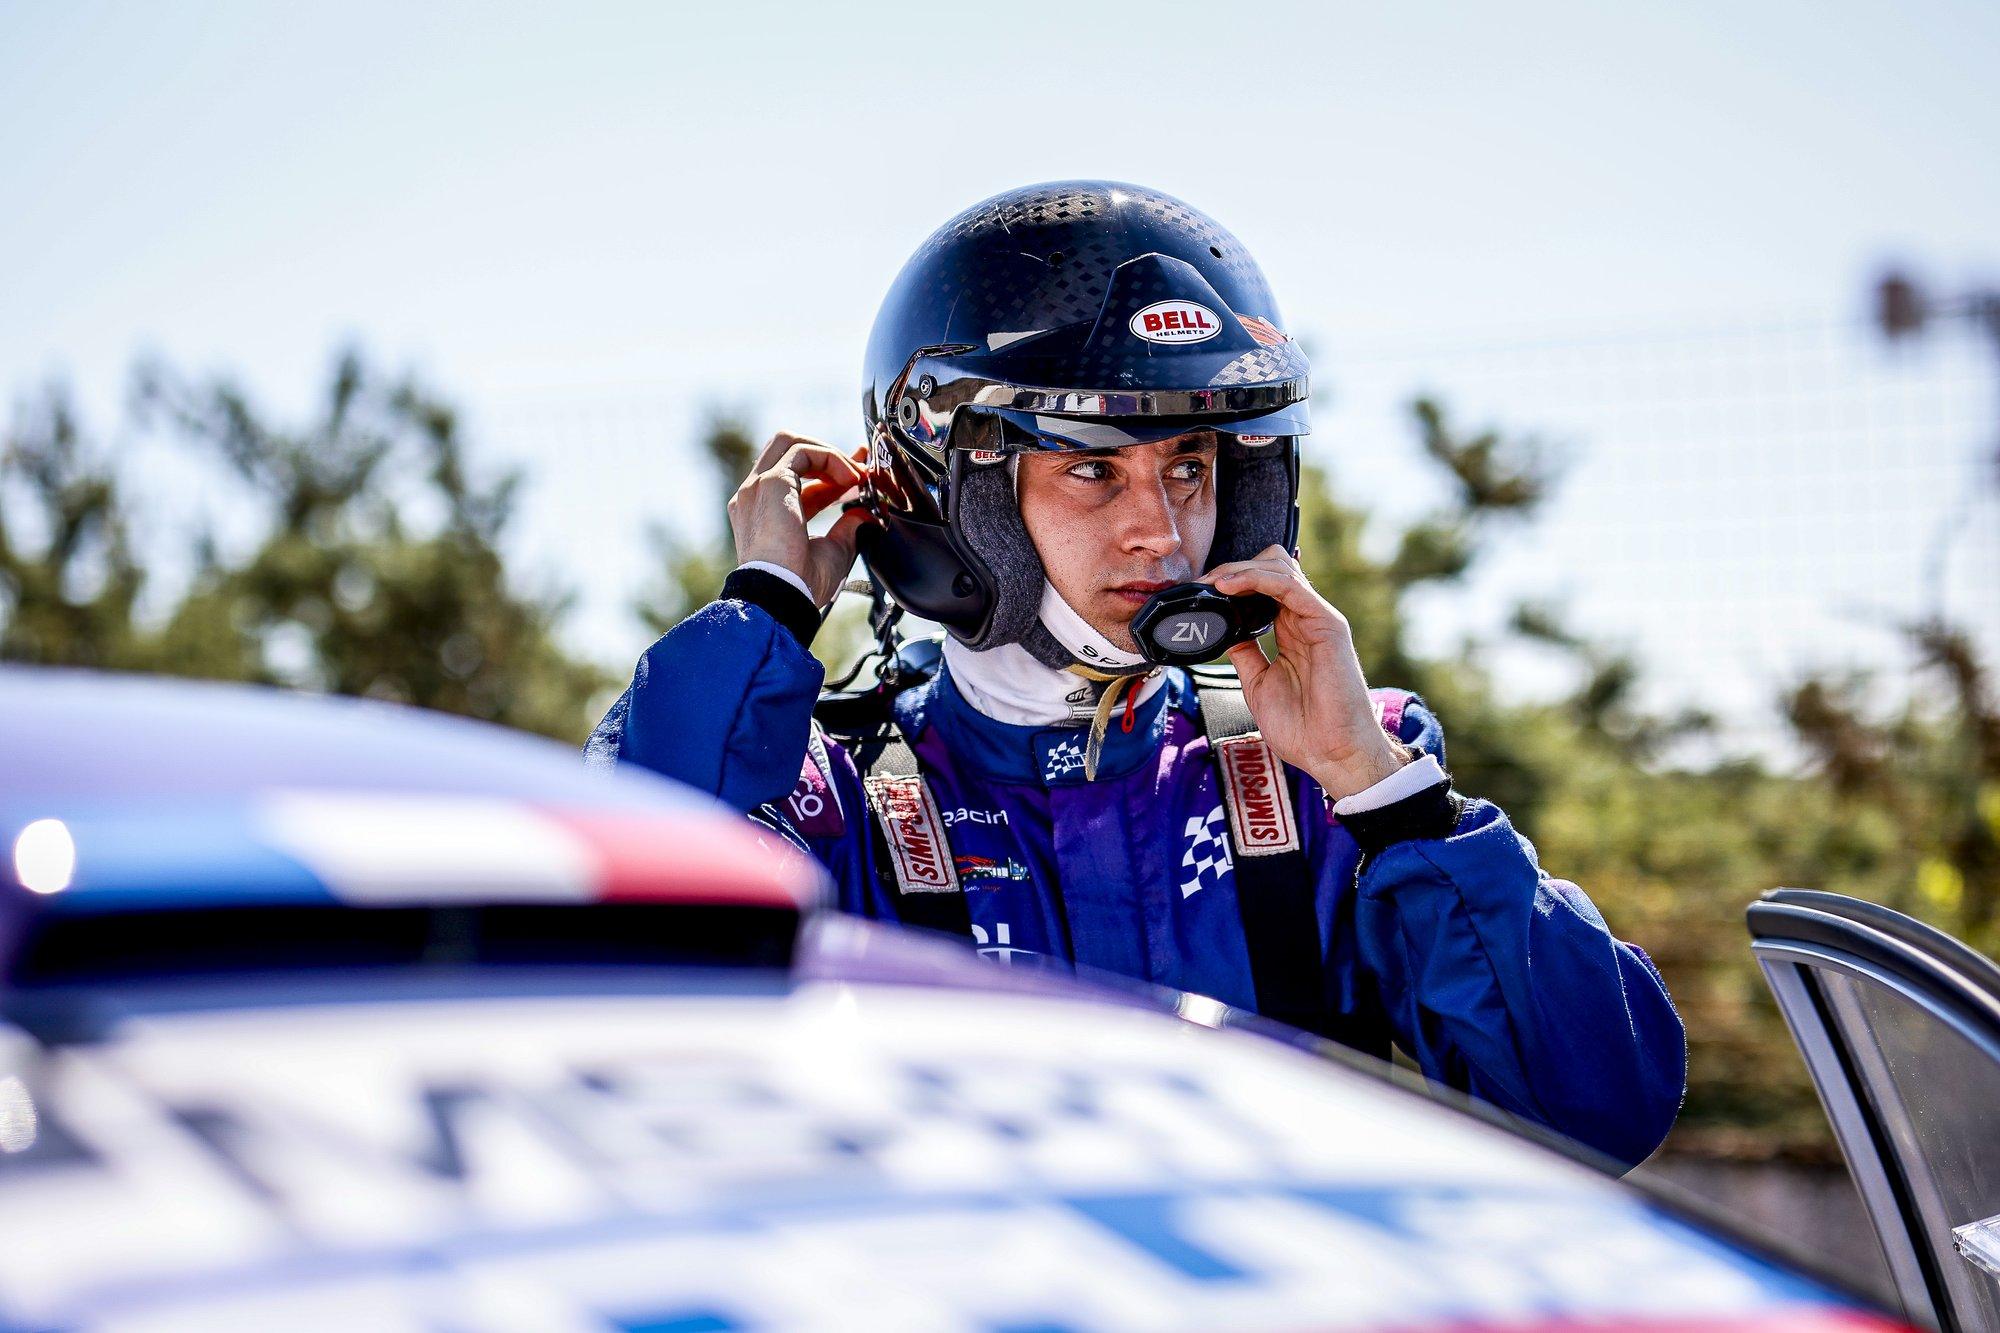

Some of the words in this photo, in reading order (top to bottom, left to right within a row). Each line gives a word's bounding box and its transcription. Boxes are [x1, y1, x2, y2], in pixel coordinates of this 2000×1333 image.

[1143, 311, 1212, 332] BELL
[1156, 329, 1205, 337] HELMETS
[1171, 621, 1209, 646] ZN
[1234, 748, 1280, 841] SIMPSON
